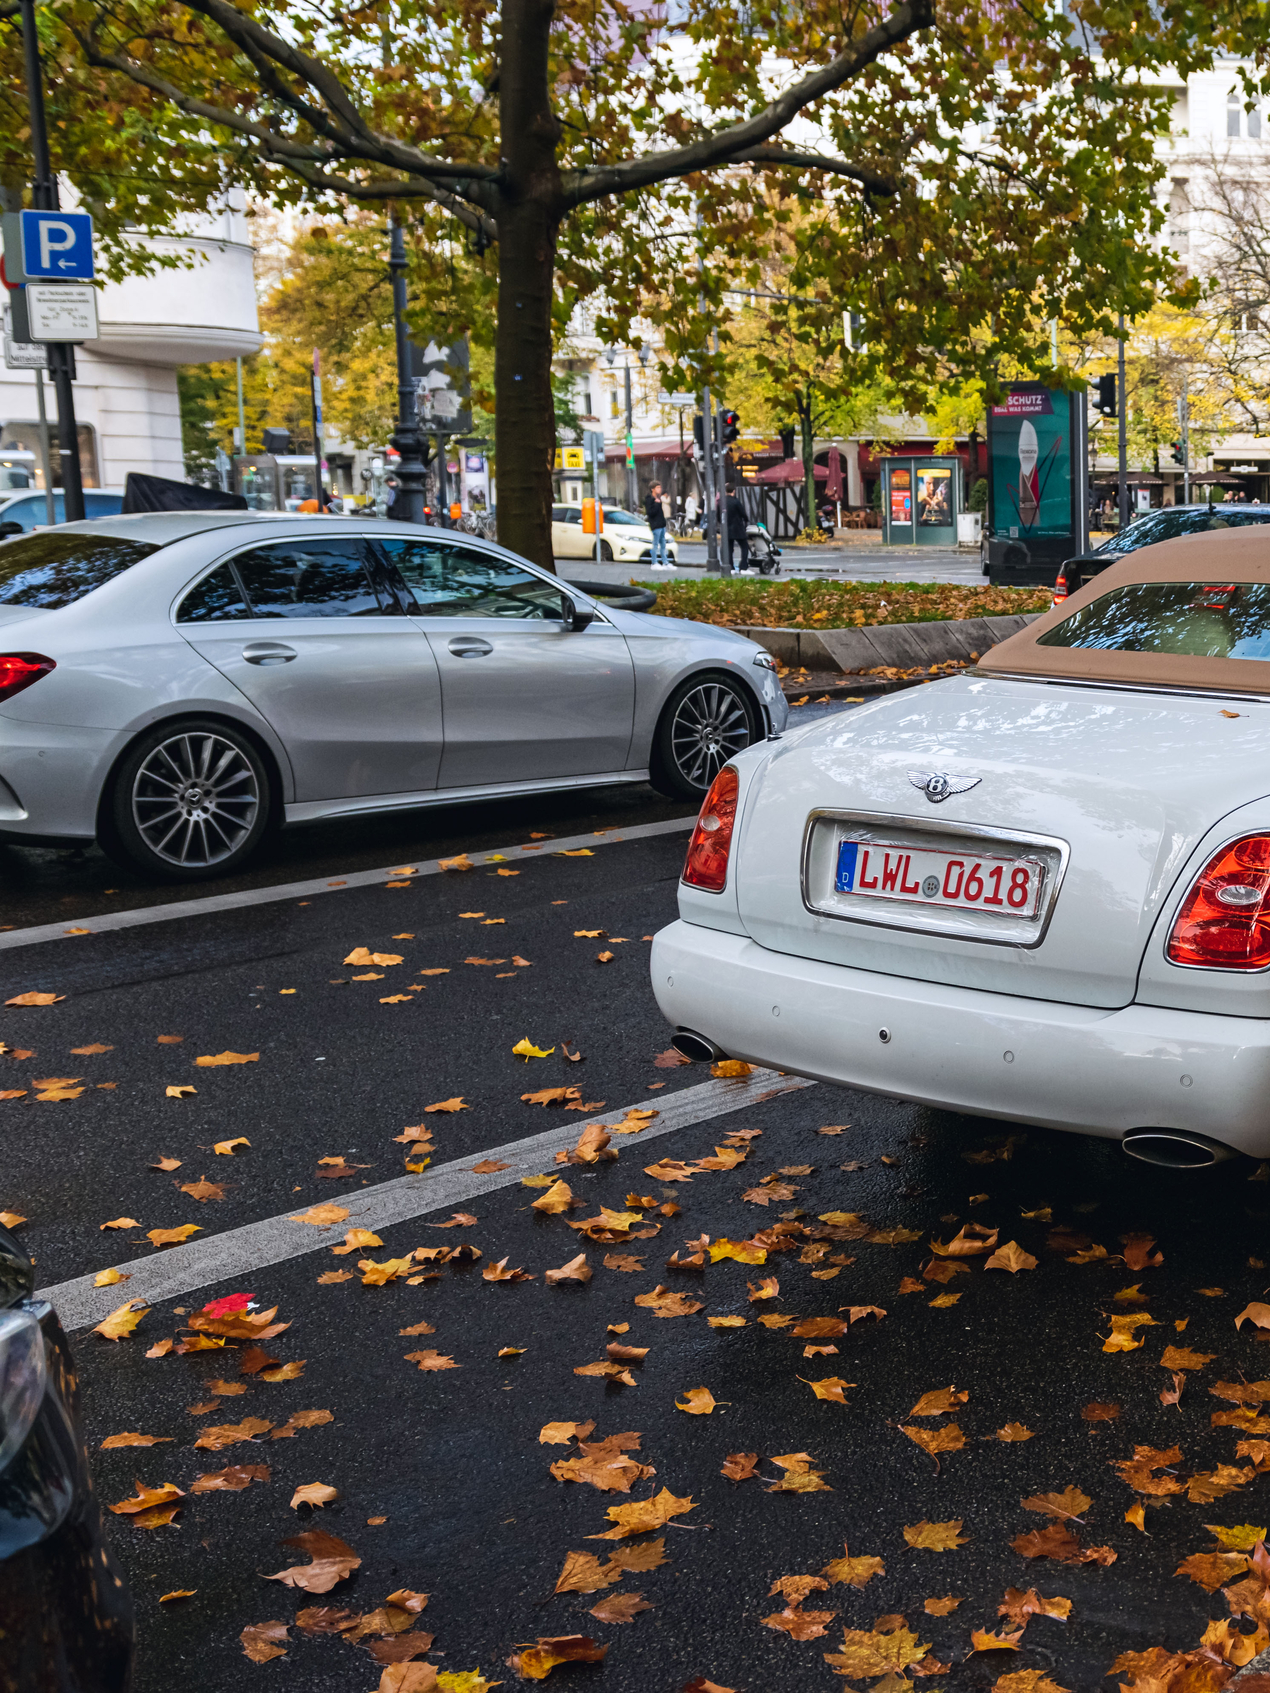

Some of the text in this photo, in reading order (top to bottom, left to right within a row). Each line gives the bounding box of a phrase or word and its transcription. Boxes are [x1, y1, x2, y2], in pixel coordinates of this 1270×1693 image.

[38, 219, 77, 269] P
[566, 460, 581, 468] TAXI
[842, 850, 1030, 908] D LWL 0618
